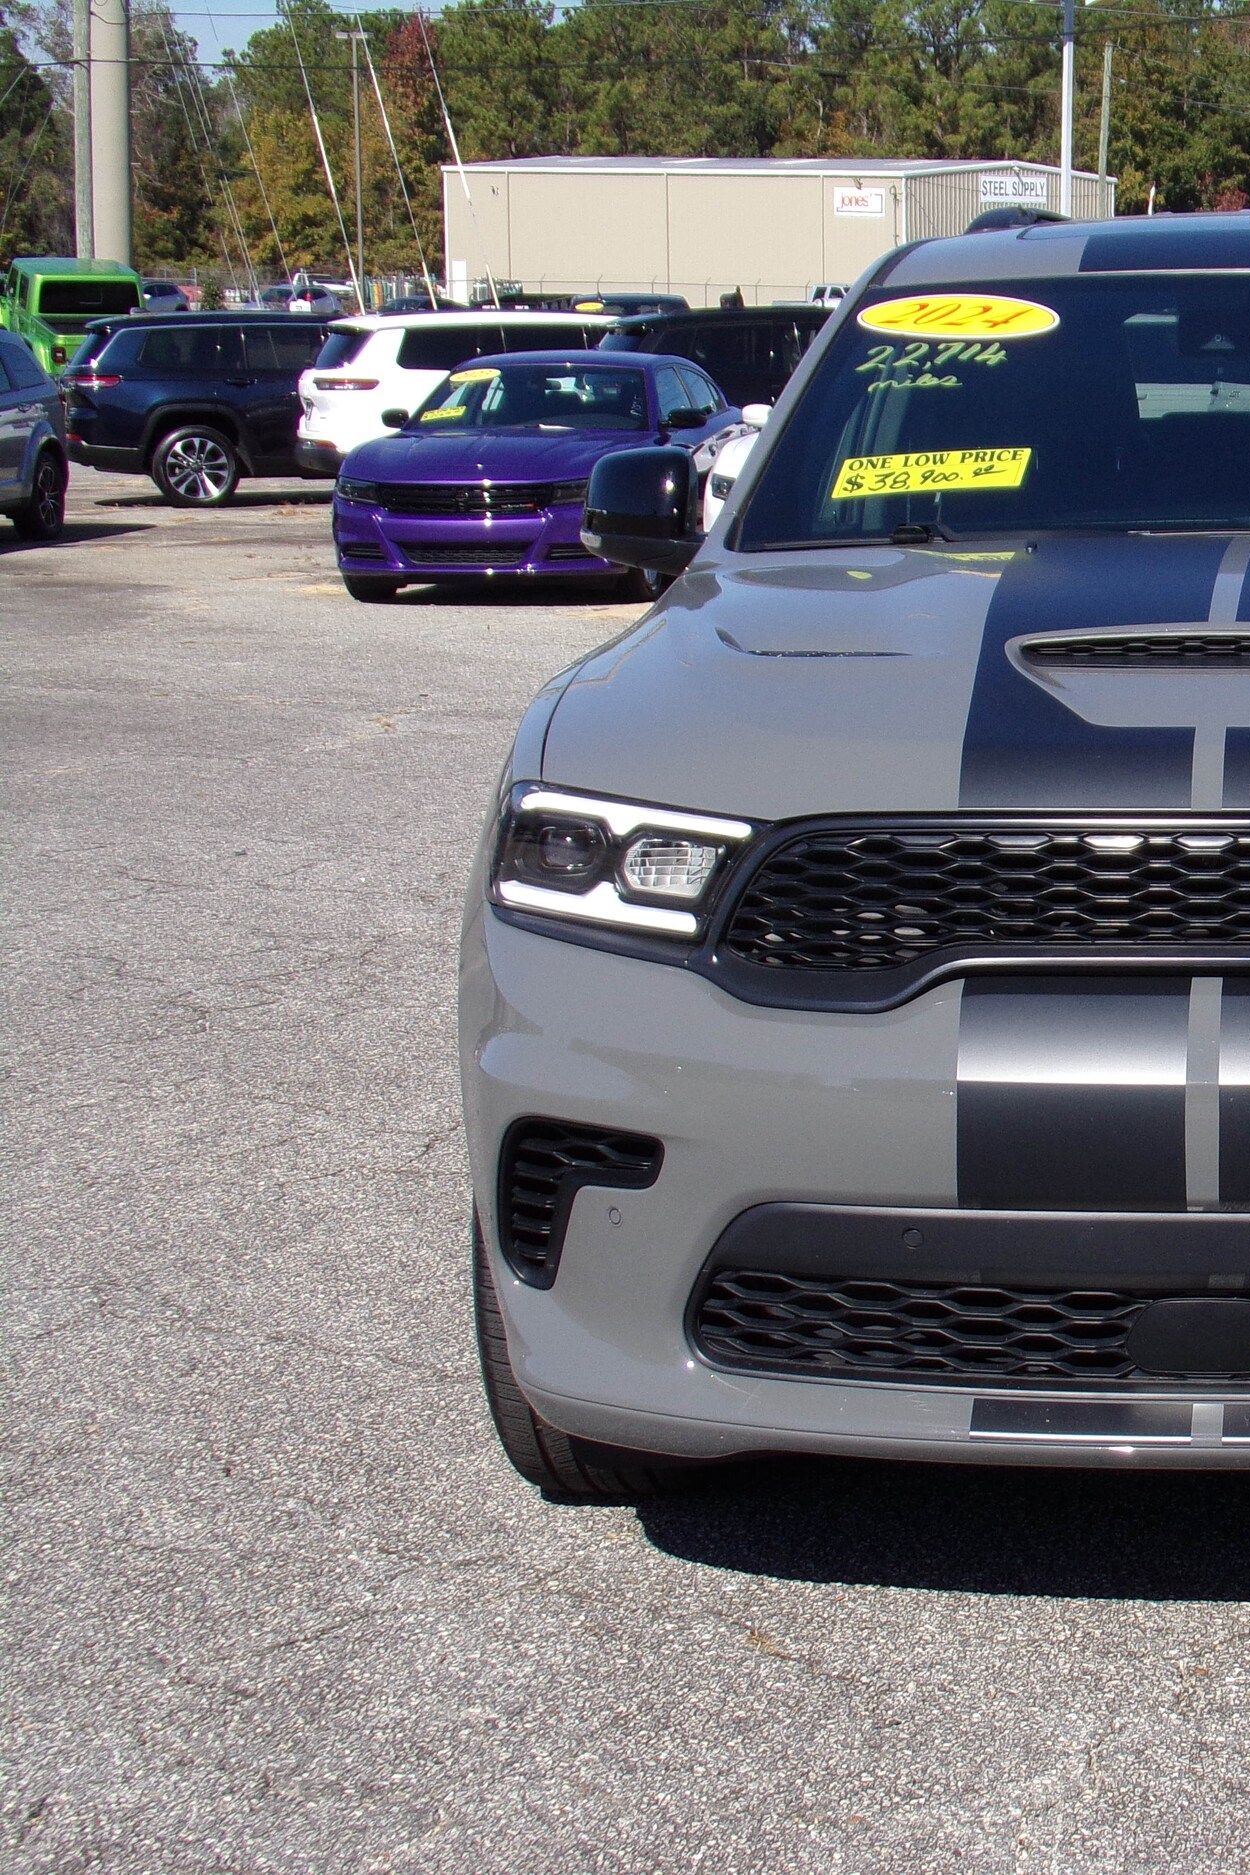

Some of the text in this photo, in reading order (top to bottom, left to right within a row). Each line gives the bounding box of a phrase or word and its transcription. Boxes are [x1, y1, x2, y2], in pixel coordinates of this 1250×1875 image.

[981, 180, 1045, 197] STEEL SUPPLY
[840, 193, 869, 209] jones
[877, 302, 1034, 329] 2024
[855, 341, 1008, 373] 22,714
[867, 372, 963, 393] miles
[848, 449, 1025, 472] ONE LOW PRICE
